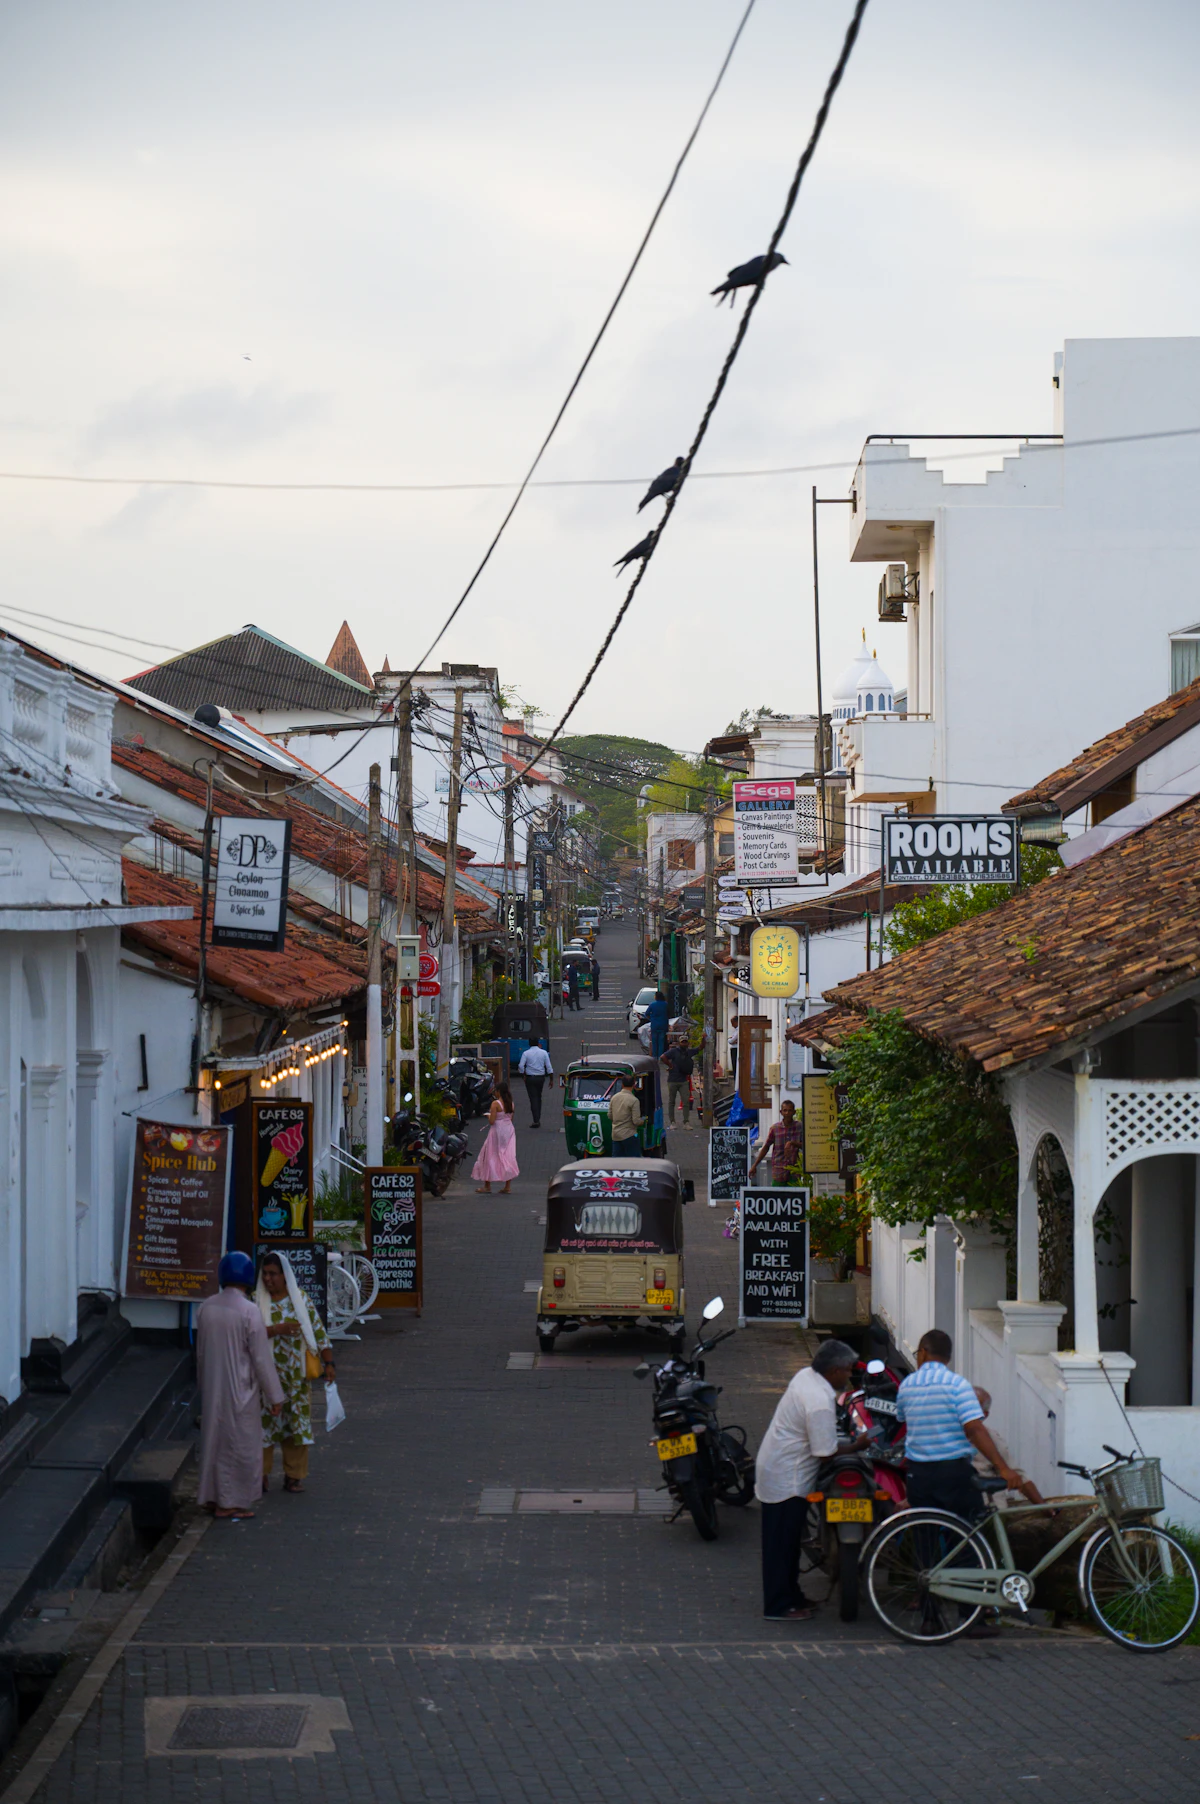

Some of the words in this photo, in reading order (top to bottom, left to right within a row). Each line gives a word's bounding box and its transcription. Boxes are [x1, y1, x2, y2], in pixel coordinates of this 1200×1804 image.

[740, 784, 791, 799] Sega
[738, 801, 791, 810] GALLERY
[741, 813, 763, 821] Canvas
[764, 811, 793, 821] Paintings
[742, 832, 775, 841] Souvenirs
[890, 822, 1012, 857] ROOMS
[238, 833, 267, 868] DP
[742, 842, 769, 851] Memory
[769, 841, 787, 849] Cards
[743, 852, 762, 860] Wood
[763, 851, 791, 860] Carvings
[743, 861, 757, 870] Post
[758, 861, 777, 869] Cards
[893, 859, 1011, 874] AVAILABLE
[237, 871, 263, 885] Ceylon
[228, 884, 269, 899] Cinnamon
[235, 903, 251, 916] Spice
[252, 903, 265, 916] Hub
[758, 934, 777, 956] DAIRY
[780, 935, 793, 957] KING
[760, 964, 774, 977] HOME
[776, 965, 791, 977] MADE
[142, 1152, 183, 1172] Spice
[187, 1155, 217, 1171] Hub
[283, 1166, 303, 1177] Dairy
[576, 1170, 648, 1178] GAME
[148, 1175, 169, 1185] Spices
[180, 1178, 203, 1187] Coffee
[147, 1187, 181, 1198] Cinnamon
[182, 1190, 198, 1198] Leaf
[198, 1191, 209, 1199] Oil
[372, 1190, 393, 1198] Home
[394, 1189, 415, 1198] made
[154, 1196, 170, 1204] Bark
[171, 1196, 182, 1205] Oil
[146, 1204, 158, 1214] Tea
[159, 1206, 179, 1216] Types
[745, 1198, 802, 1216] ROOMS
[145, 1215, 180, 1225] Cinnamon
[181, 1218, 214, 1228] Mosquito
[384, 1222, 392, 1231] &
[745, 1221, 801, 1232] AVAILABLE
[145, 1223, 165, 1232] Spray
[144, 1234, 158, 1243] Gift
[158, 1236, 178, 1245] Items
[373, 1235, 412, 1245] DAIRY
[760, 1239, 788, 1248] WITH
[143, 1244, 178, 1255] Cosmetics
[372, 1246, 387, 1257] Ice
[388, 1246, 416, 1257] Cream
[143, 1255, 181, 1266] Accessories
[373, 1259, 416, 1269] Cappuccino
[752, 1253, 790, 1267] FREE
[160, 1271, 185, 1281] Church
[745, 1269, 805, 1281] BREAKFAST
[379, 1279, 413, 1289] moothie
[747, 1285, 769, 1296] AND
